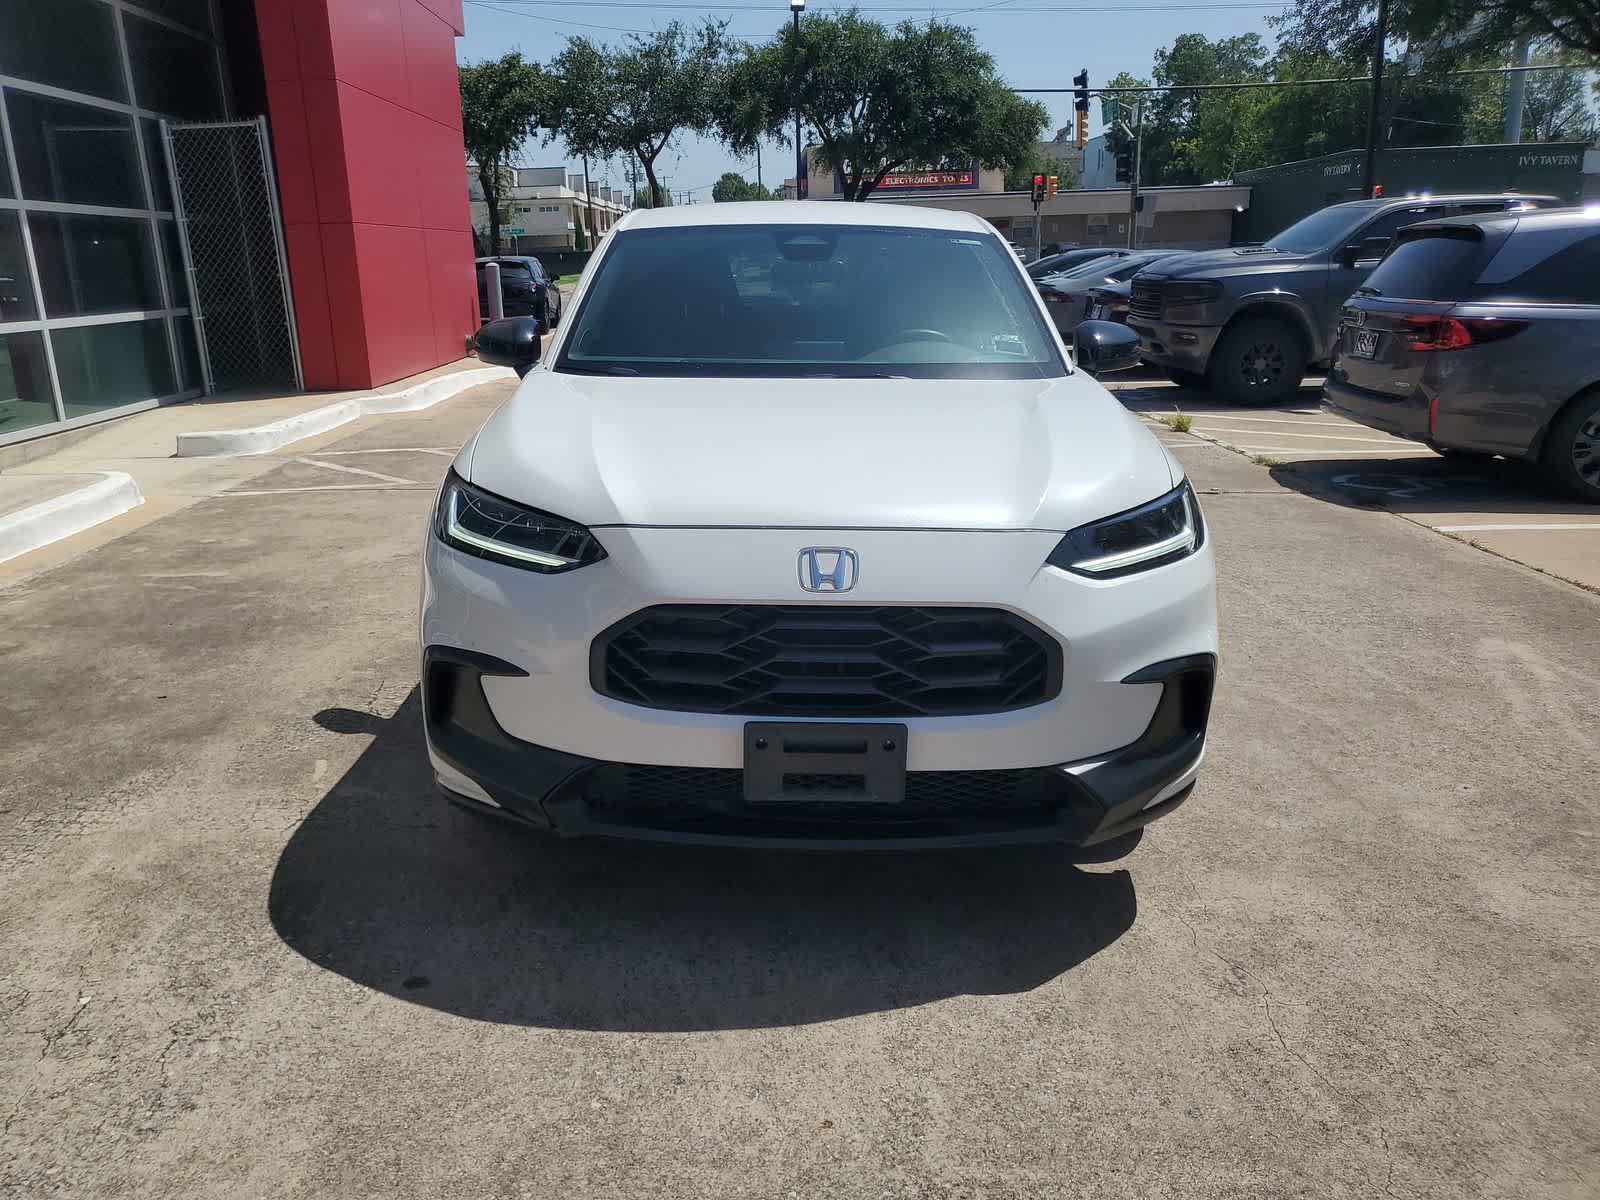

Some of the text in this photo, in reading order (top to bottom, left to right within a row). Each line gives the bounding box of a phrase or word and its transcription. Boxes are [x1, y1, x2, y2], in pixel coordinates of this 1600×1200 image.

[1519, 154, 1577, 166] IVY TAVERN
[885, 175, 938, 185] ELECTRONICS
